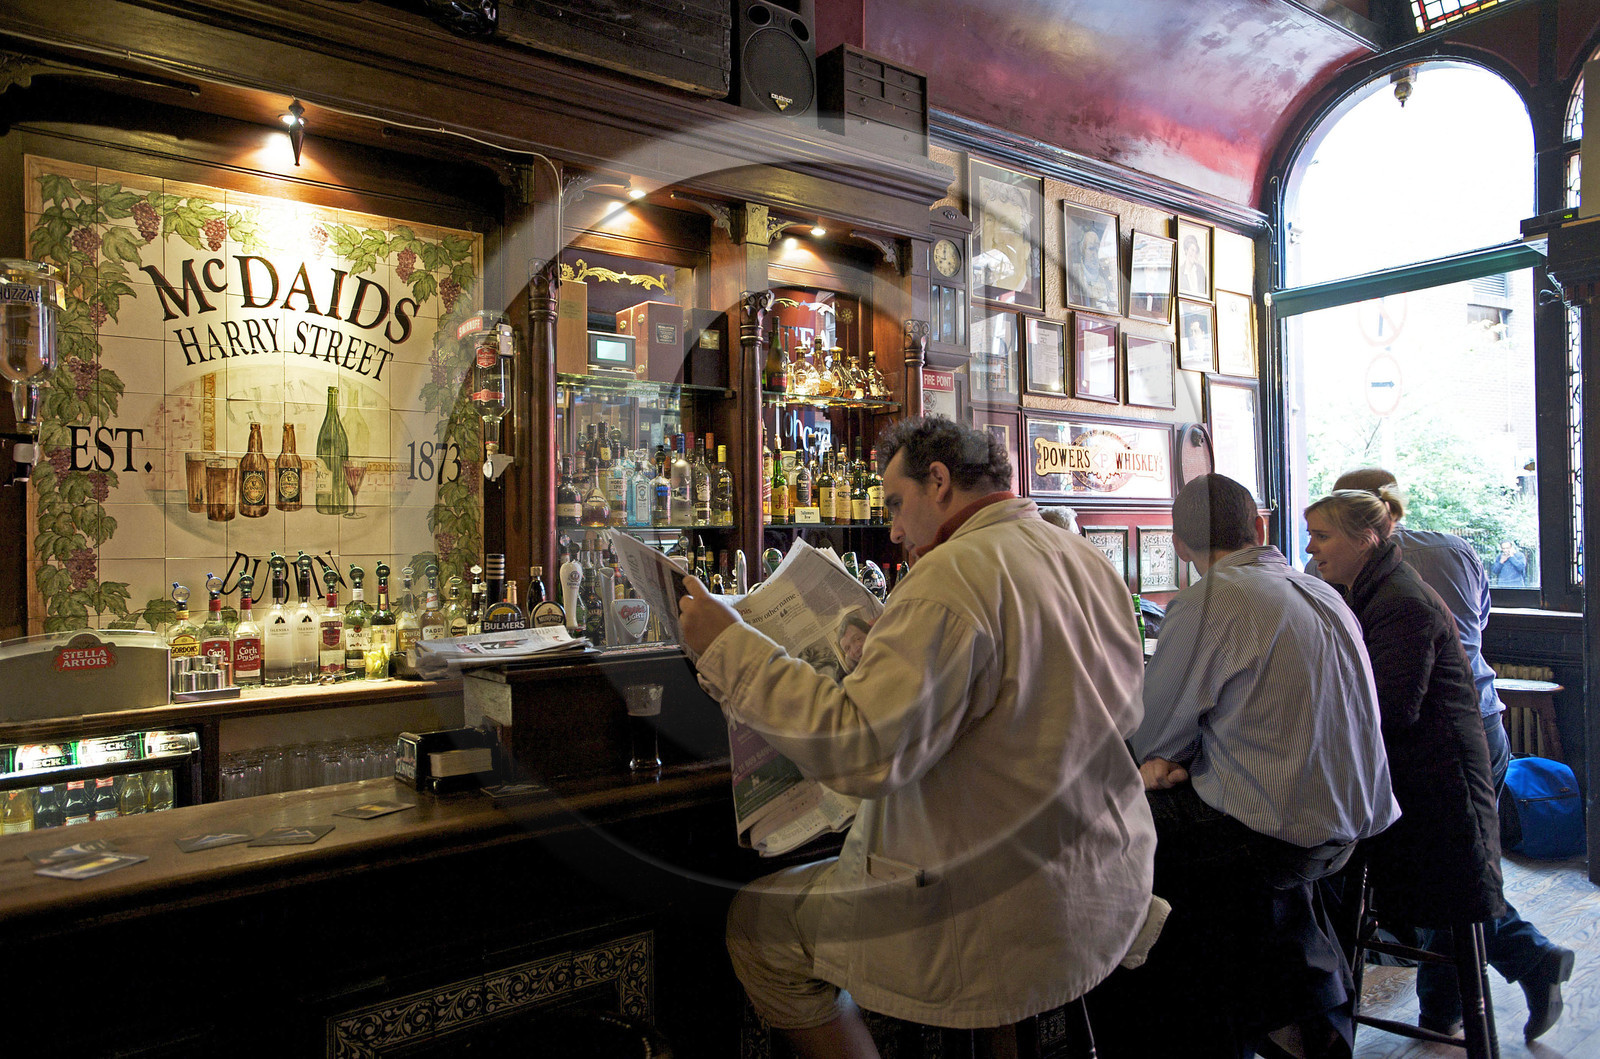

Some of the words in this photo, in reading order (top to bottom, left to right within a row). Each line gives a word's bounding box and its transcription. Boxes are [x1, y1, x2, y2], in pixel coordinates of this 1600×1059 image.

[140, 254, 421, 345] McDAIDS
[173, 318, 281, 366] HARRY
[292, 320, 395, 382] STREET
[923, 374, 936, 386] FIRE
[937, 375, 952, 388] POINT
[67, 425, 153, 474] EST.
[407, 440, 462, 485] 1873
[1043, 446, 1091, 469] POWER'S
[1115, 452, 1159, 472] WHISKEY
[752, 614, 765, 624] any
[763, 605, 781, 622] other
[778, 594, 796, 610] name
[483, 620, 525, 631] BULMERS
[62, 649, 107, 660] STELLA
[62, 657, 108, 668] ARTOIS
[239, 646, 258, 656] Cork
